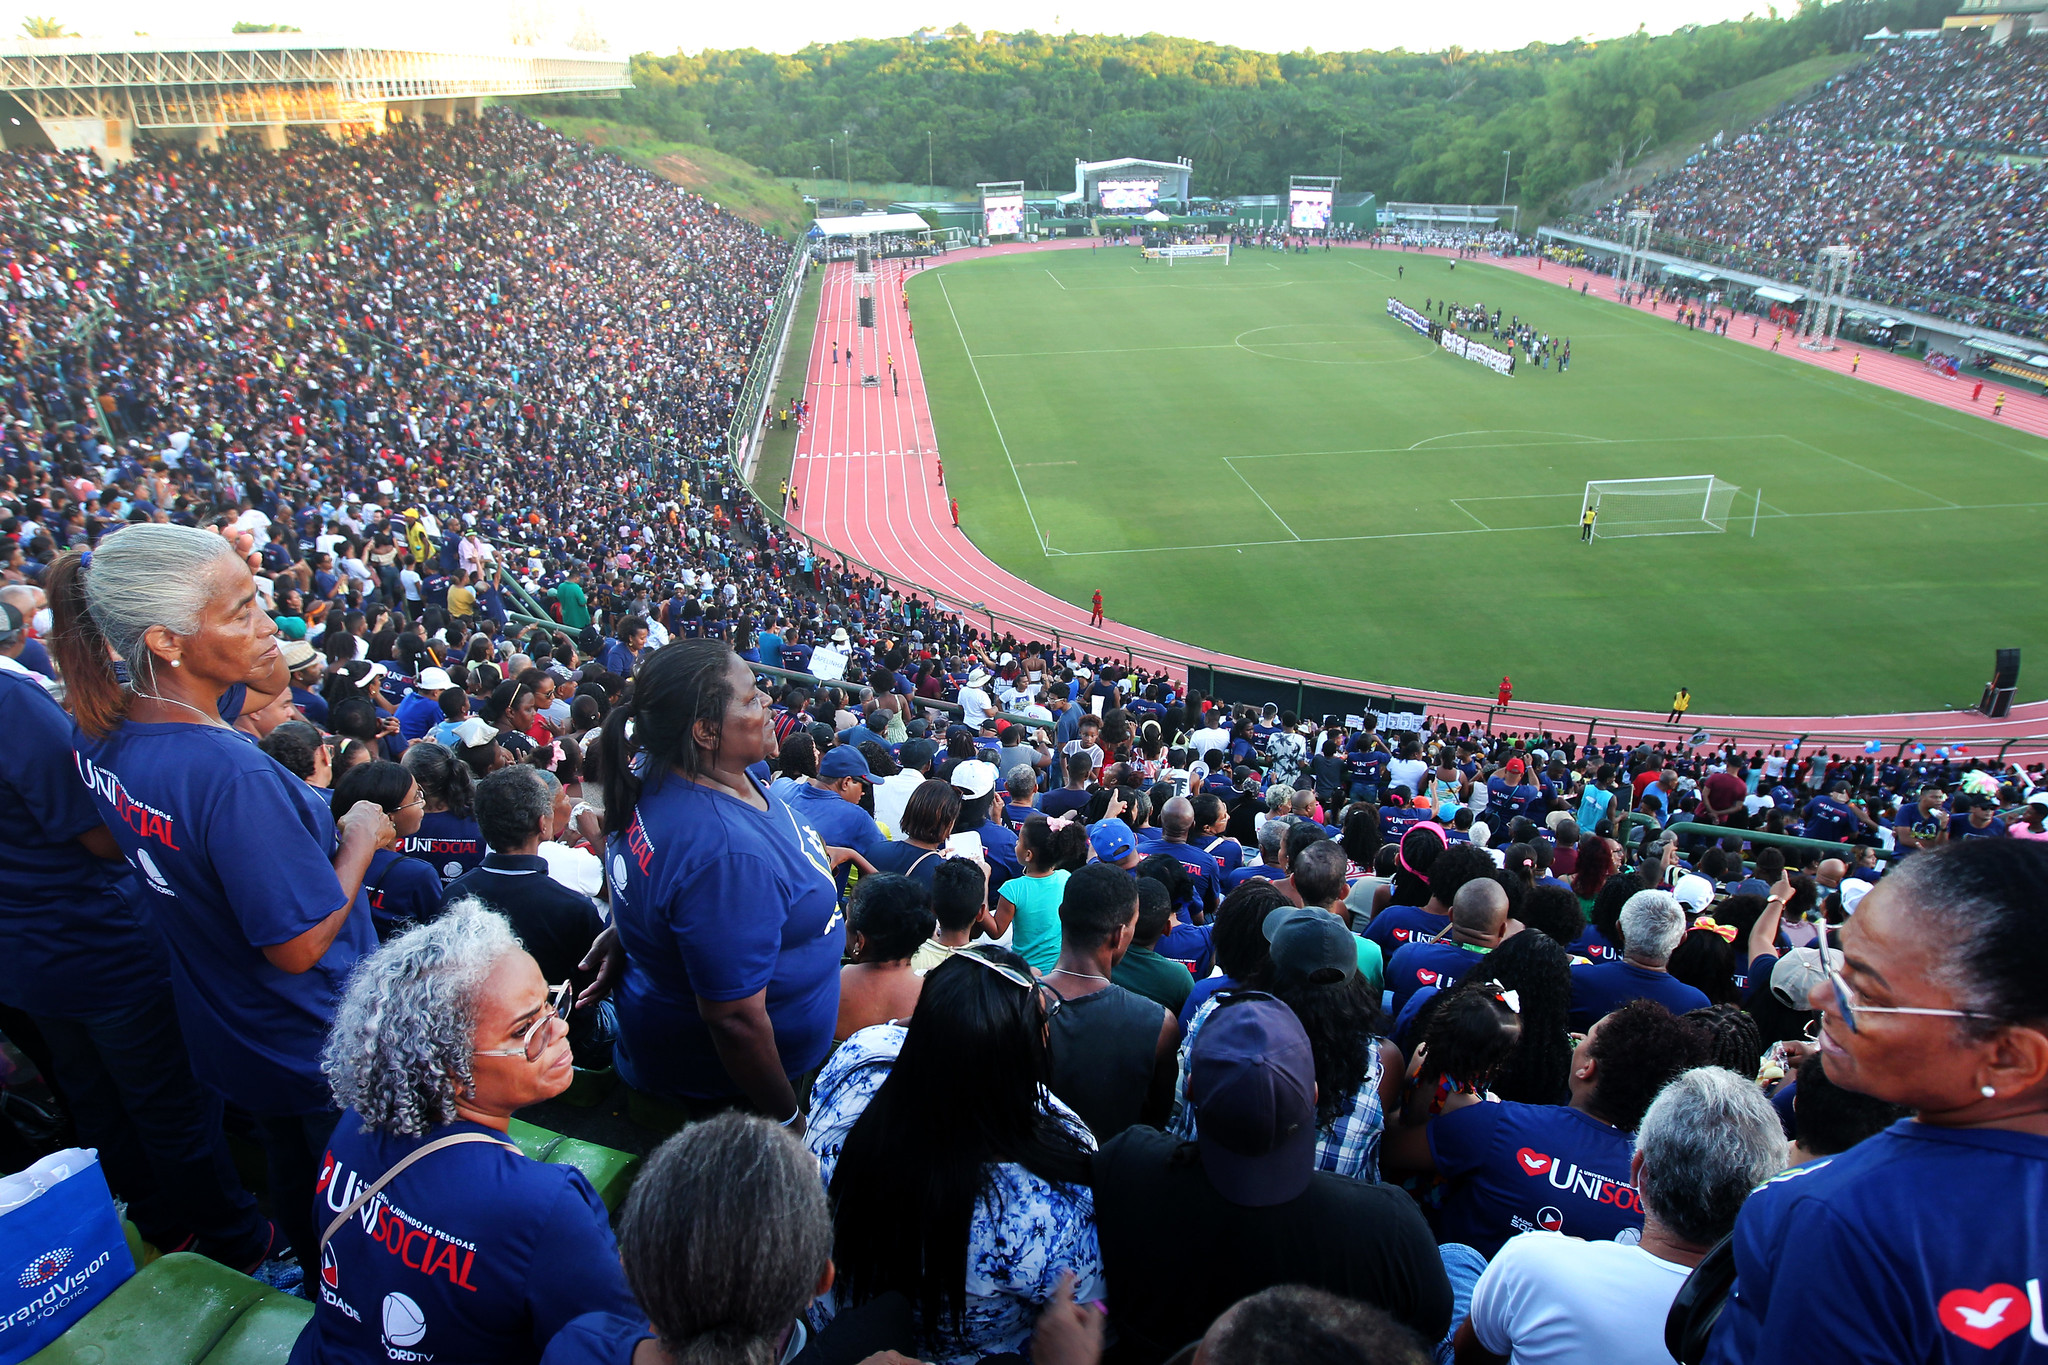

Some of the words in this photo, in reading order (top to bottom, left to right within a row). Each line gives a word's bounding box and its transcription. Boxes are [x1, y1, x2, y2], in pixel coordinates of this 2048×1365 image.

[812, 652, 844, 670] CAPELINHA
[76, 750, 180, 851] UNISOCIAL
[404, 836, 478, 854] UNISOCIAL
[1584, 1170, 1615, 1184] UNIVERSAL
[327, 1161, 478, 1292] UNISOCIAL
[357, 1179, 363, 1187] A
[389, 1204, 422, 1229] AJUDANDO
[421, 1224, 434, 1234] AS
[26, 1319, 37, 1328] by
[37, 1285, 89, 1320] FOTOTICA
